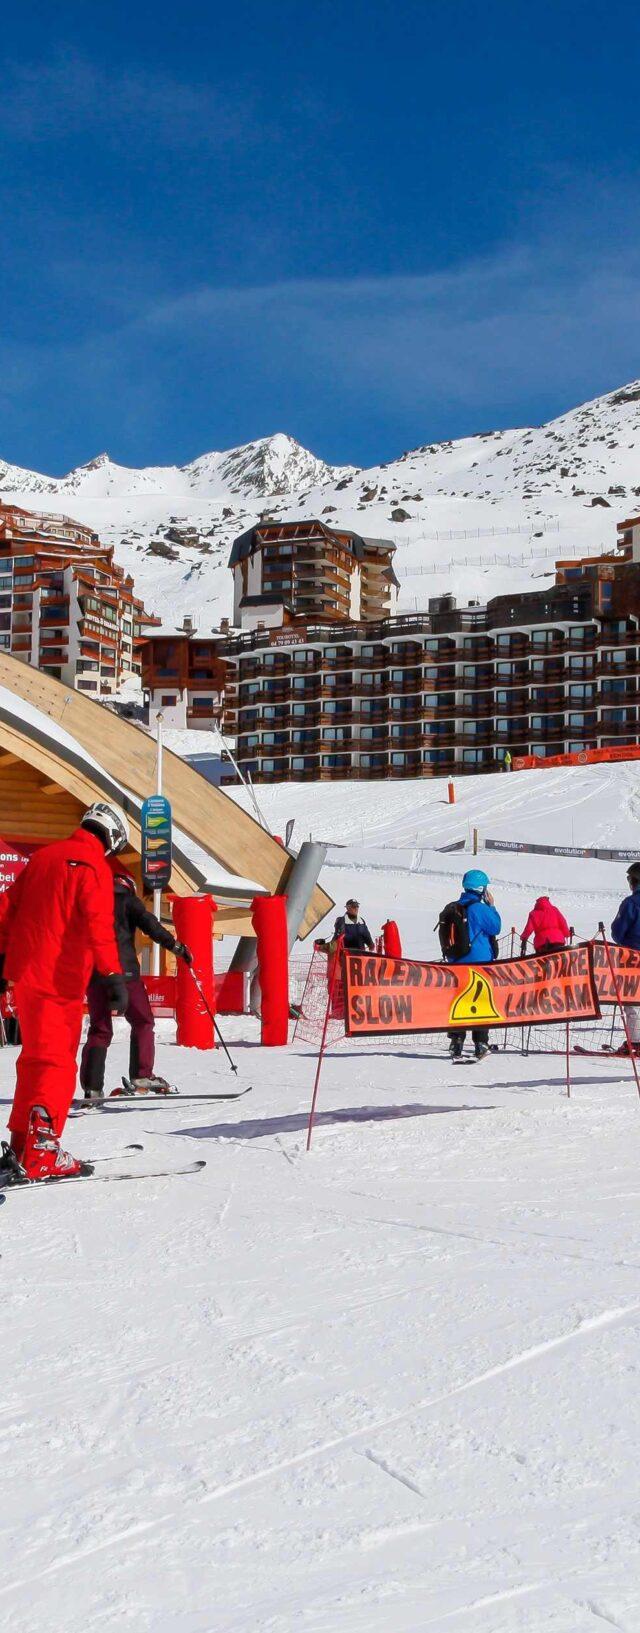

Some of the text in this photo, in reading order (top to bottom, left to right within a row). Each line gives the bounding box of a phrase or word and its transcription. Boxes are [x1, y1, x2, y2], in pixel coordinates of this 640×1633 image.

[350, 957, 459, 988] RALENTIR
[482, 949, 588, 987] RALLENTARE
[594, 945, 640, 969] RALE
[350, 994, 412, 1026] SLOW
[504, 983, 592, 1018] LANGSAM
